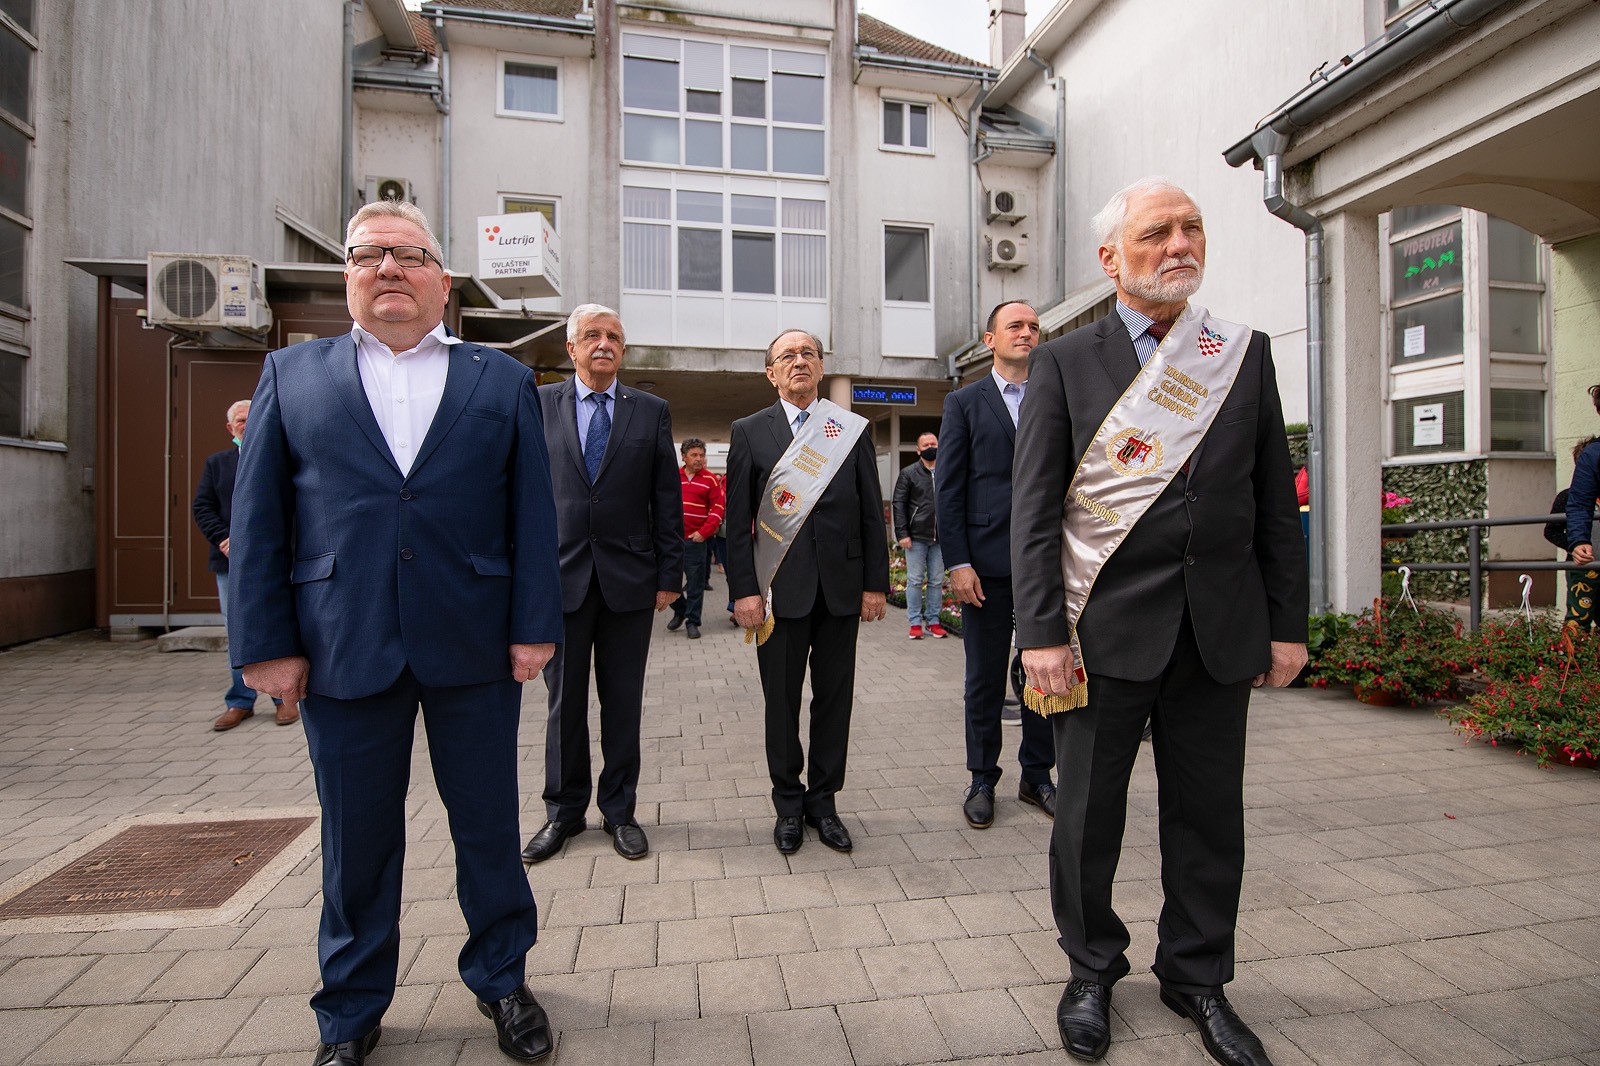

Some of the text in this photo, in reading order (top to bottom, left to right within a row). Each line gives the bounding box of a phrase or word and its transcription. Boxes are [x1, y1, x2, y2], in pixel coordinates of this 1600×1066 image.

[498, 235, 536, 247] Lutrija
[1403, 229, 1455, 258] VIDEOTEKA
[491, 259, 530, 269] OVLAŠTENI
[494, 267, 527, 275] PARTNER
[1160, 379, 1199, 408] GARDA
[1163, 364, 1209, 399] ZRINSKA
[1147, 386, 1198, 421] ČAKOVEC
